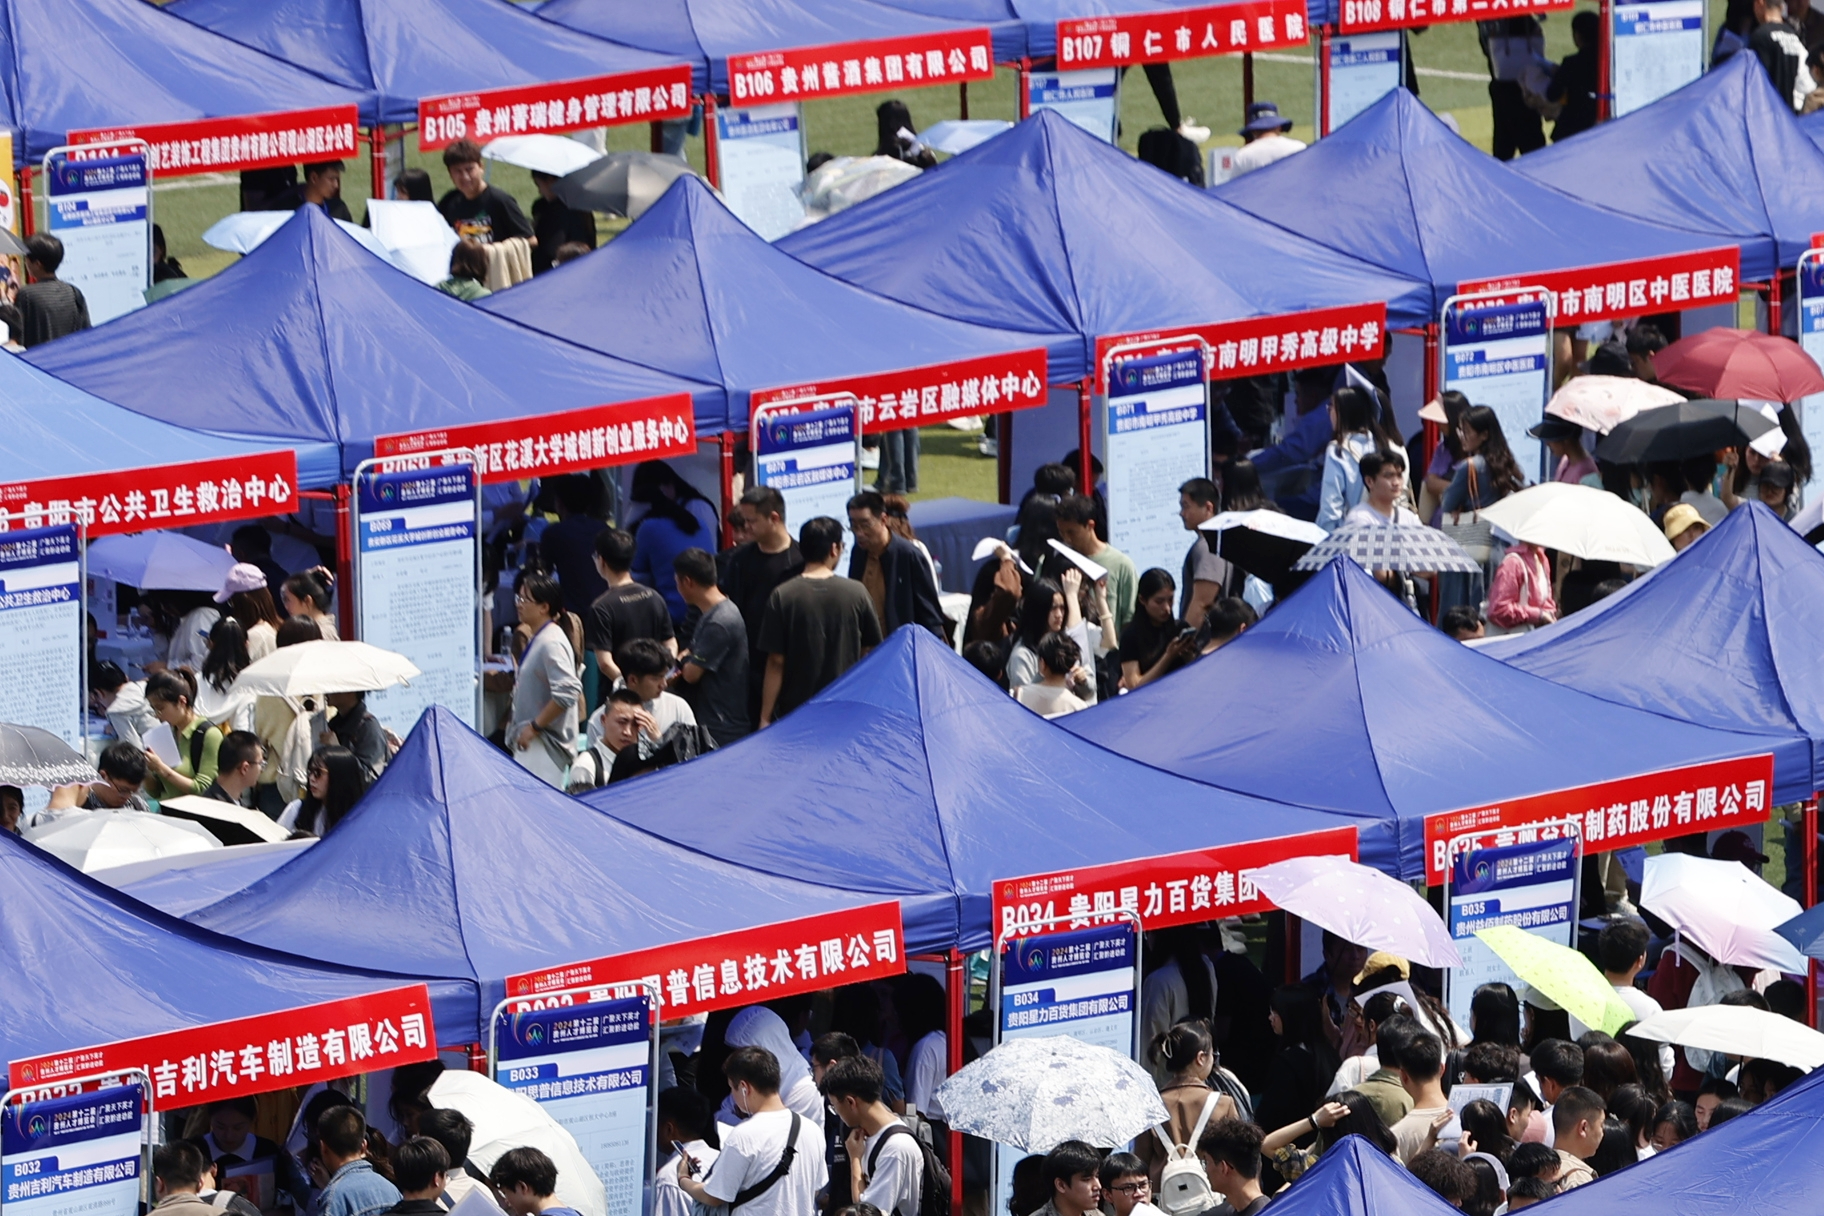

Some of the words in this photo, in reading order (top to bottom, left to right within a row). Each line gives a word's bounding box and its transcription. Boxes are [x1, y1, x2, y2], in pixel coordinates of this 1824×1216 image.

[1063, 35, 1102, 61] B107
[1111, 13, 1304, 59] 铜仁市人民医院
[735, 71, 773, 98] B106
[425, 114, 466, 142] B105
[1157, 322, 1379, 370] 市南明甲秀高级中学
[23, 473, 291, 529] 贵阳市公共卫生救治中心
[1002, 901, 1056, 939] B034
[1462, 902, 1485, 916] B035
[1008, 995, 1128, 1028] 贵阳星力百货集团有限公司
[1014, 992, 1039, 1007] B034
[510, 1067, 539, 1081] B033
[8, 1161, 135, 1200] 贵州吉利汽车制造有限公司
[14, 1161, 41, 1177] B032
